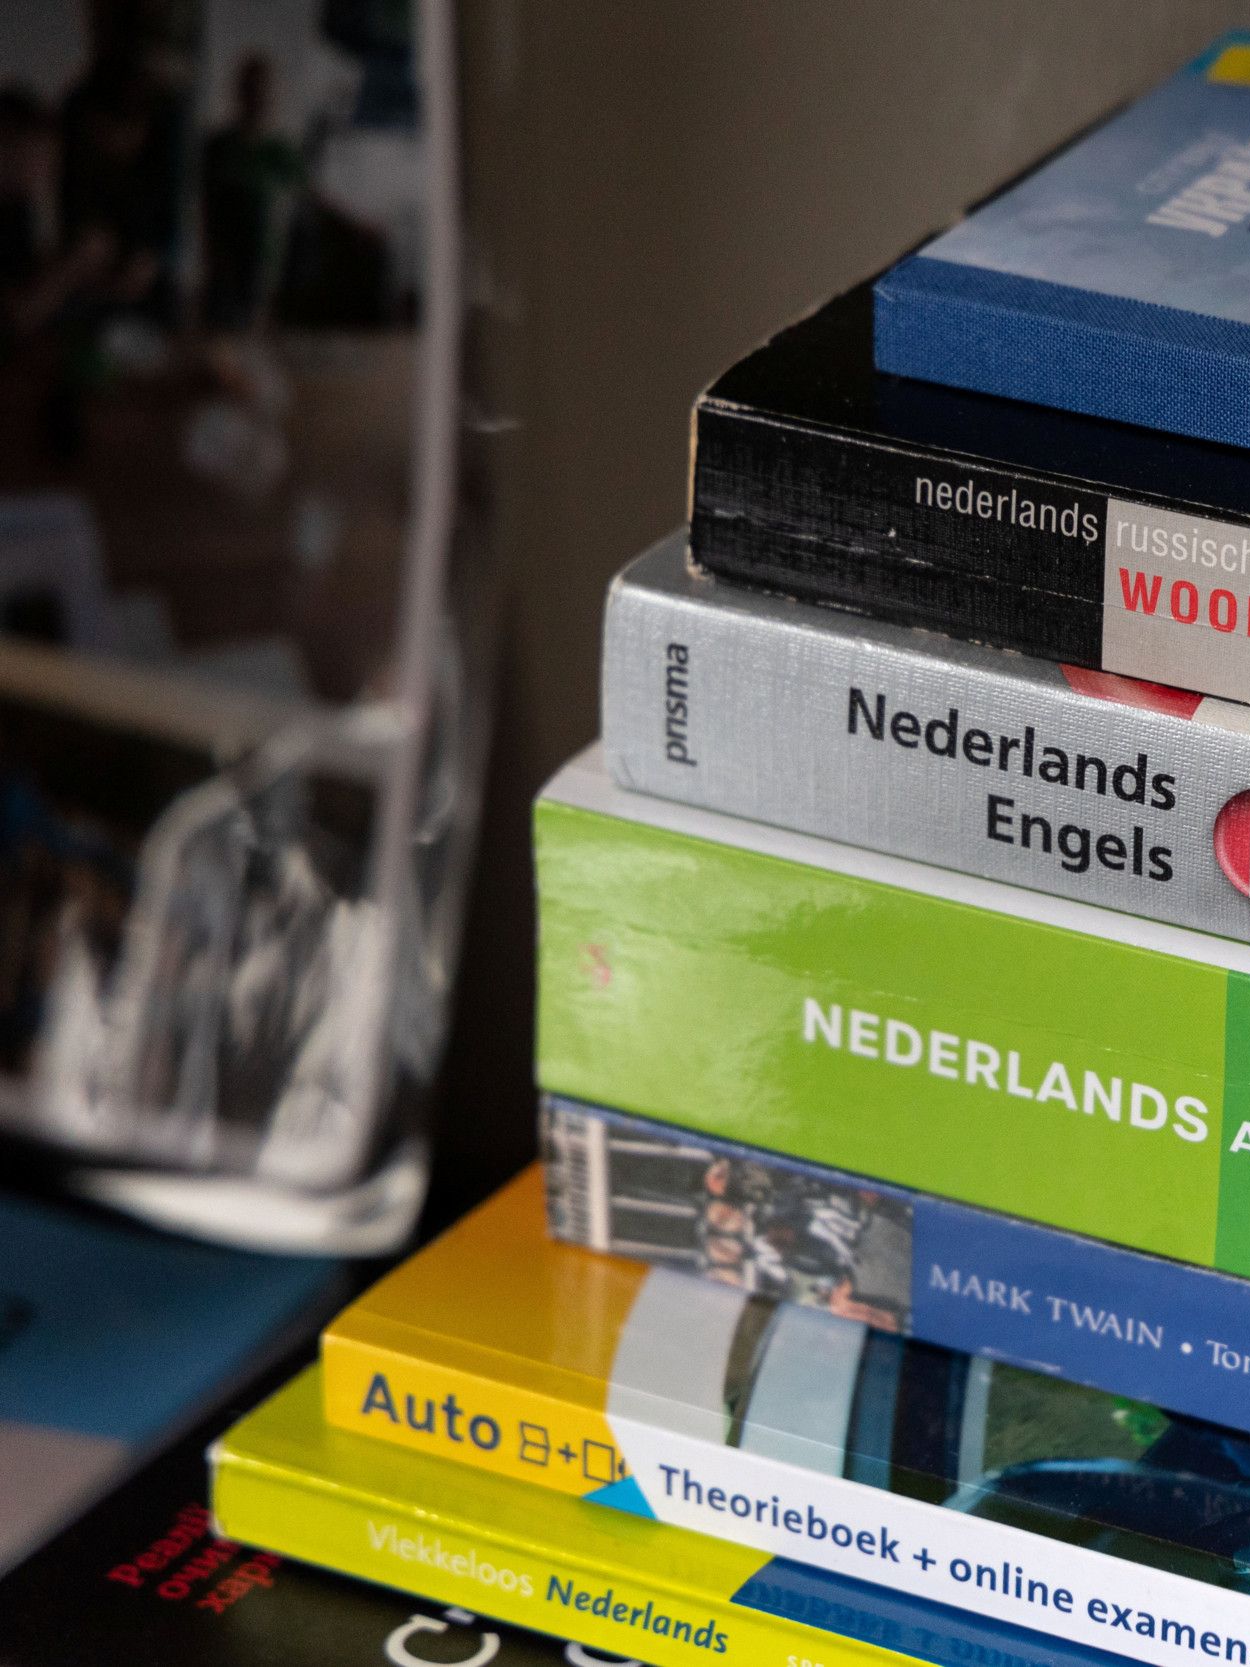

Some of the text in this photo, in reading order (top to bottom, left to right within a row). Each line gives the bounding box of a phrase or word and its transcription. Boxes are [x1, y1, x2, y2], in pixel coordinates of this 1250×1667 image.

[916, 476, 1098, 542] nederlands
[666, 642, 697, 767] prisma
[846, 687, 1177, 812] Nederlands
[986, 795, 1174, 882] Engels
[803, 997, 1209, 1143] NEDERLANDS
[928, 1264, 1032, 1316] MARK
[1047, 1296, 1164, 1351] TWAIN
[360, 1372, 501, 1451] Auto
[366, 1520, 534, 1598] Vlekkeloos
[545, 1575, 729, 1656] Nederlands
[658, 1462, 901, 1564] Theorieboek
[912, 1546, 938, 1573] +
[950, 1562, 1073, 1615] online
